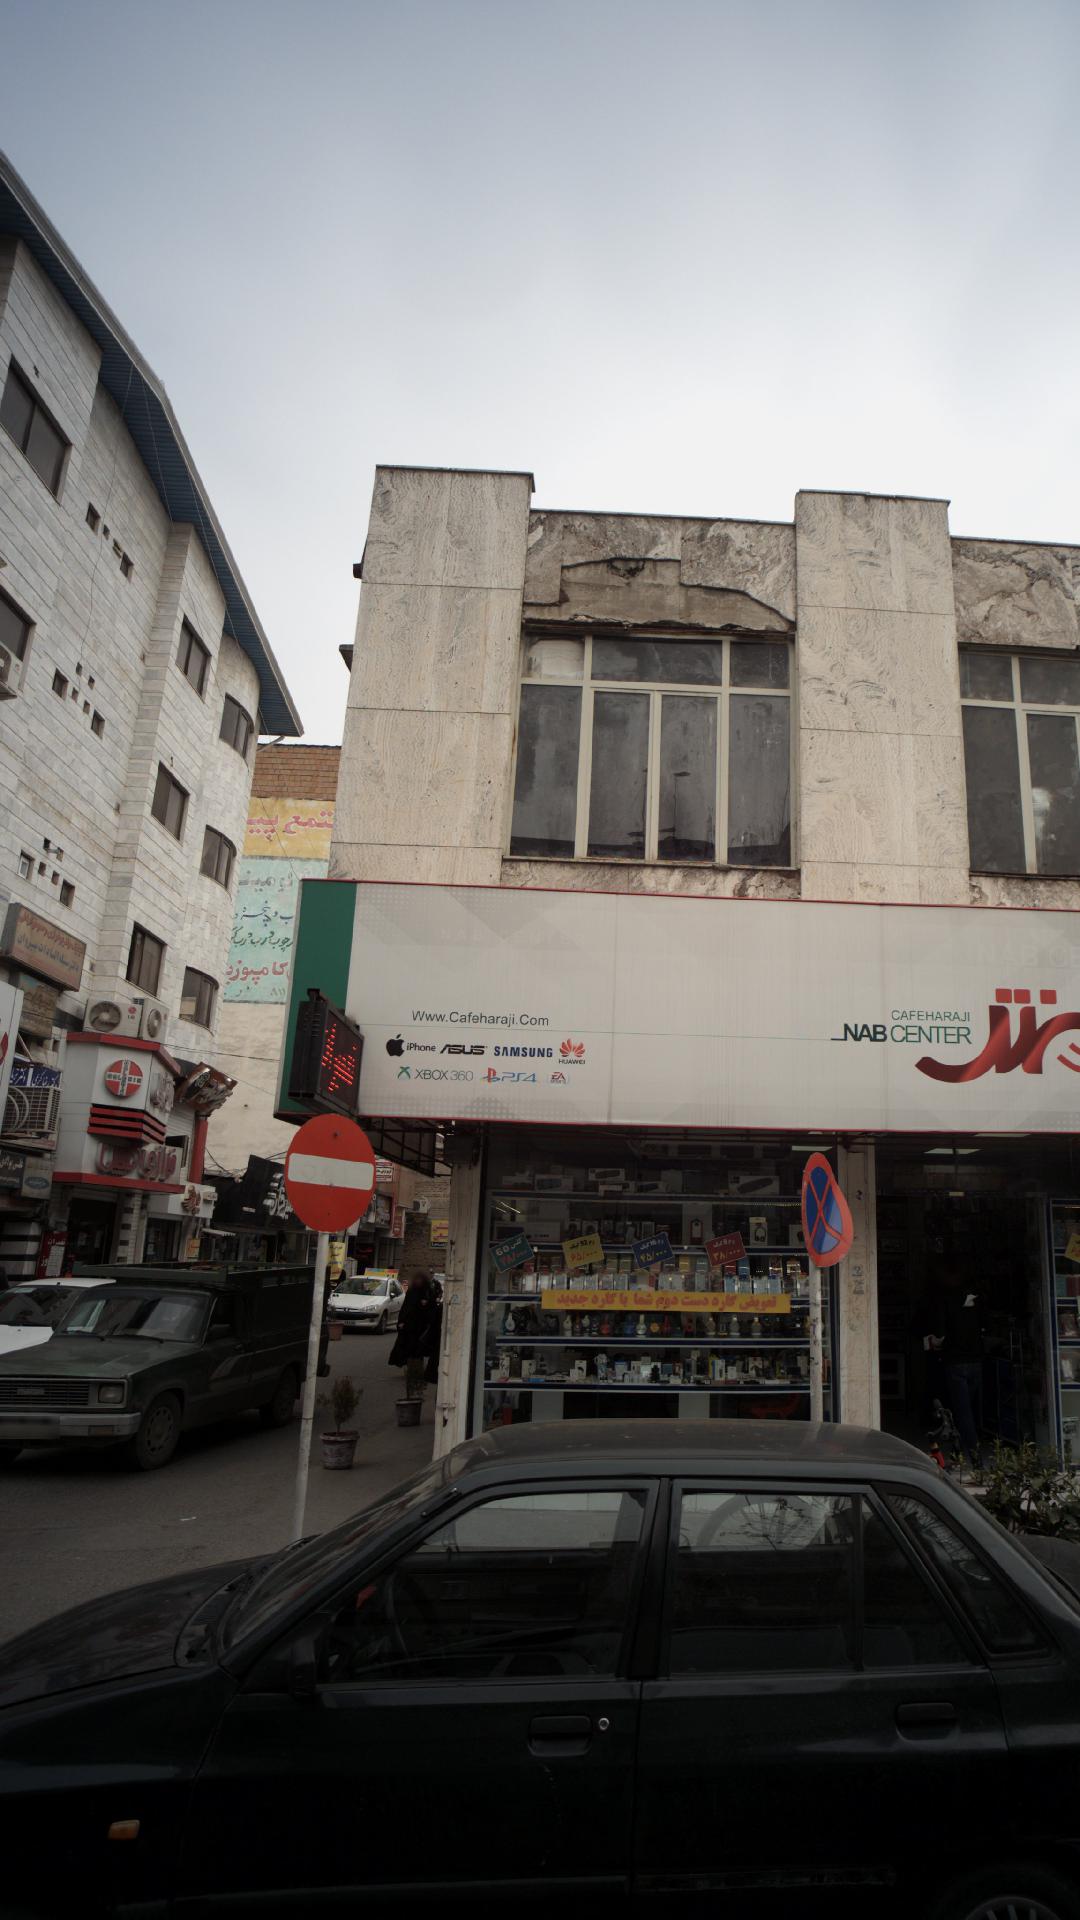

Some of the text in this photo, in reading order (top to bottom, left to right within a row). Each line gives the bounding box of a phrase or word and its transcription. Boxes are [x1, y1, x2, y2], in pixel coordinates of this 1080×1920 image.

[411, 1010, 549, 1028] Www.Cafeharaji.Com
[891, 1010, 971, 1022] CAFEHARAJI
[843, 1023, 972, 1045] NAB CENTER
[406, 1042, 436, 1053] iPhone
[440, 1044, 488, 1056] ASUS
[494, 1045, 553, 1058] SAMSUNG
[415, 1069, 449, 1081] XBOX
[450, 1069, 474, 1082] 360
[501, 1071, 537, 1083] PS4
[557, 1294, 588, 1307] جدید
[633, 1293, 653, 1306] شما
[655, 1295, 678, 1309] دوم
[681, 1295, 709, 1306] دست
[738, 1296, 777, 1310] تعویض
